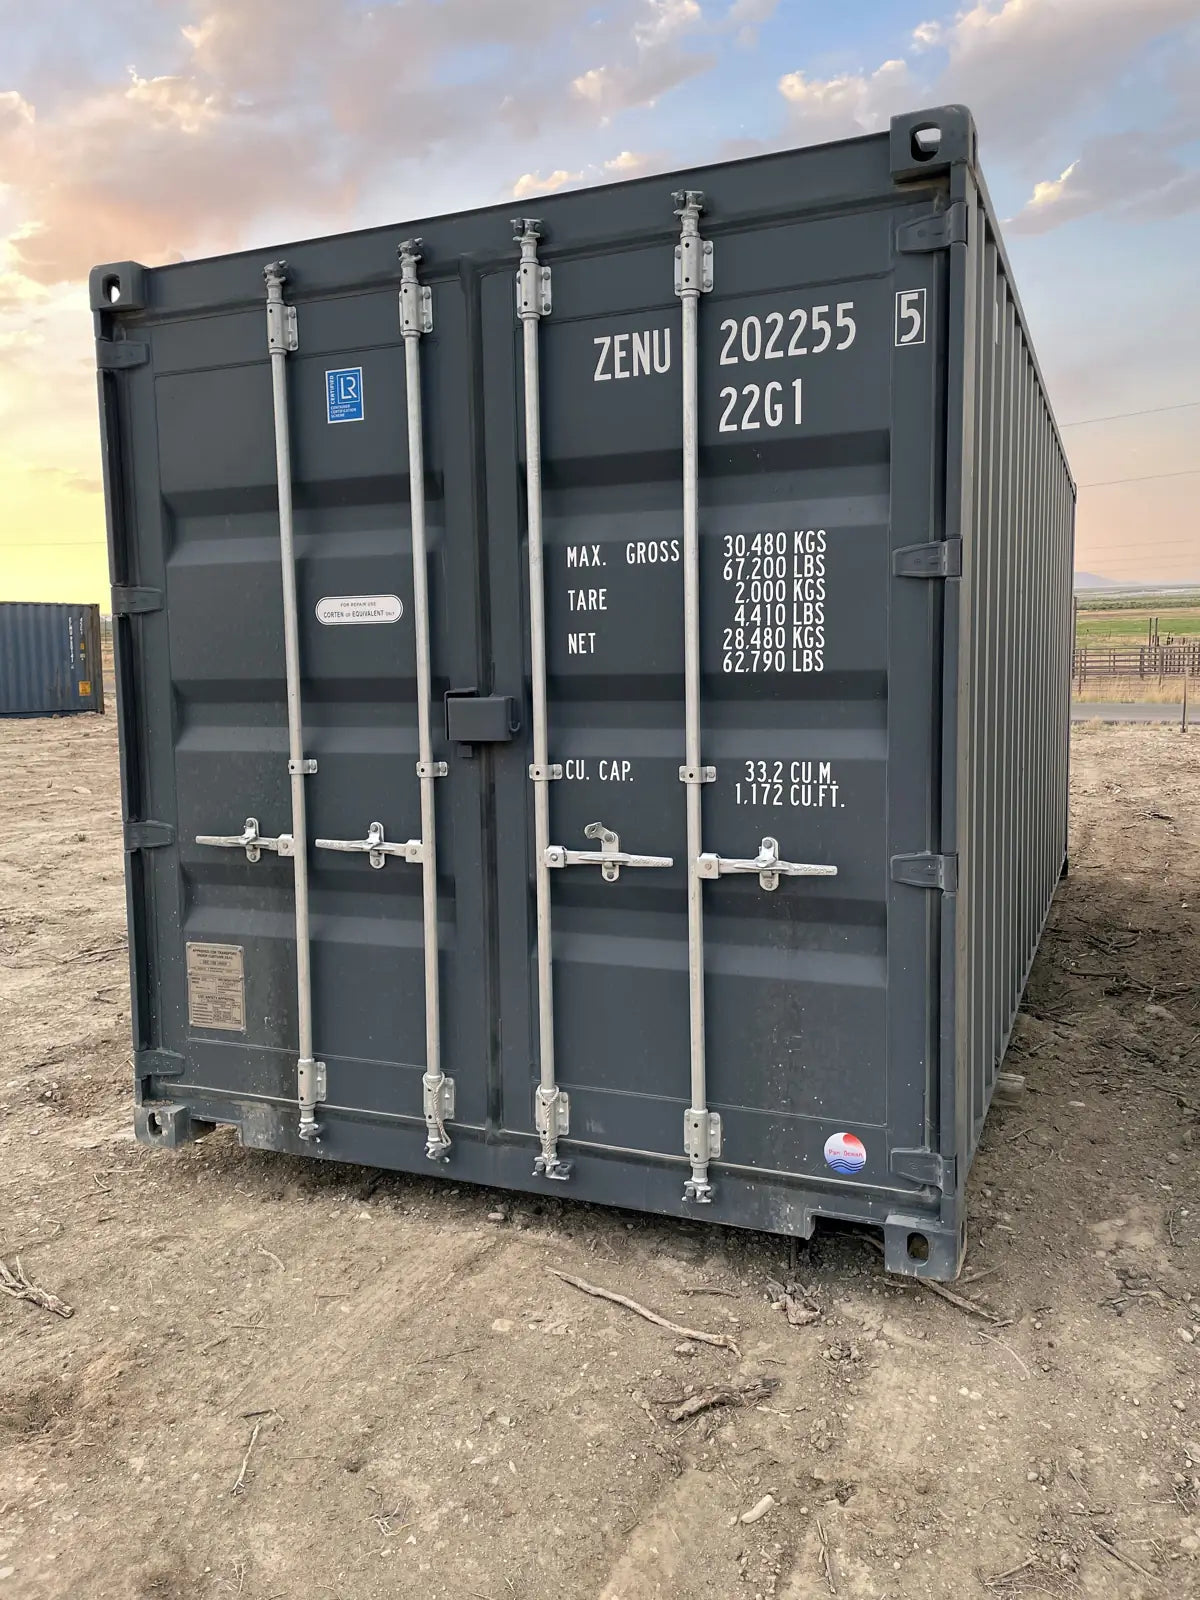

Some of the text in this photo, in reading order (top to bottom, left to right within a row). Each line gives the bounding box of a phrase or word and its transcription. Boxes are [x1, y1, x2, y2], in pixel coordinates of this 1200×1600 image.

[594, 292, 921, 381] ZENU 202255 5
[719, 378, 802, 432] 22G1
[567, 540, 680, 568] MAX. GROSS
[723, 530, 827, 557] 30,480 KGS
[723, 554, 826, 580] 67,200 LBS
[568, 588, 608, 611] TARE
[734, 578, 826, 604] 2,000 KGS
[734, 602, 825, 626] 4,410 LBS
[568, 632, 596, 654] NET
[723, 626, 825, 650] 28,480 KGS
[723, 649, 824, 673] 62,790 LBS
[566, 760, 634, 782] CU. CAP.
[744, 761, 837, 784] 33.2 CU.M.
[735, 783, 846, 808] 1,172 CU.FT.
